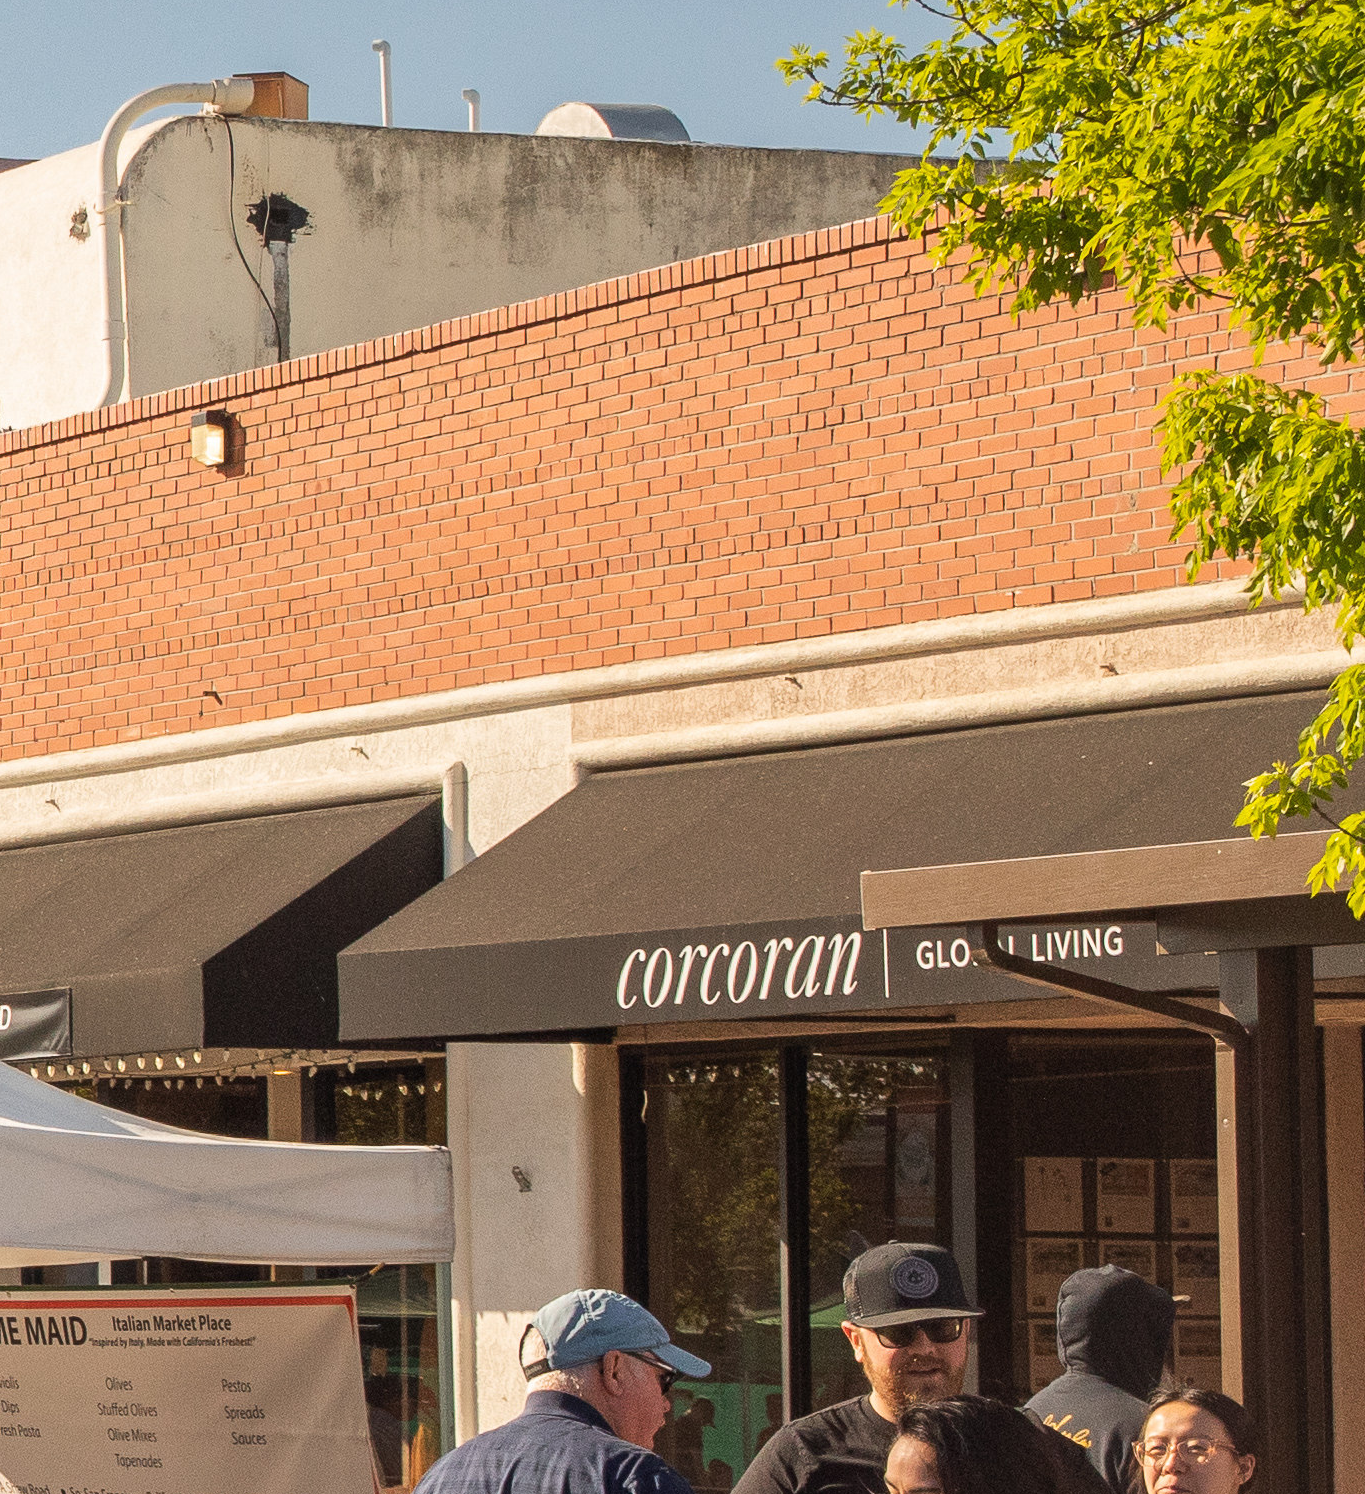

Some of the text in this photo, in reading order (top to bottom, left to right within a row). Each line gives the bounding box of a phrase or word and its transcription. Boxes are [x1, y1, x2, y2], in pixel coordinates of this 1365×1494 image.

[1031, 925, 1124, 962] LIVING
[616, 929, 863, 1010] corcoran
[24, 1315, 88, 1346] MAID
[112, 1314, 232, 1332] Italian Market Place
[146, 1337, 165, 1347] Made
[166, 1337, 181, 1347] with
[105, 1376, 134, 1391] Olives
[221, 1378, 252, 1393] Pestos
[1, 1399, 20, 1416] Dips
[97, 1402, 158, 1417] Stuffed Olives
[224, 1404, 266, 1421] Spreads
[18, 1424, 41, 1438] Pasta
[107, 1427, 157, 1443] Olive Mixes
[231, 1431, 267, 1445] Sauces
[114, 1453, 163, 1470] Tapenades
